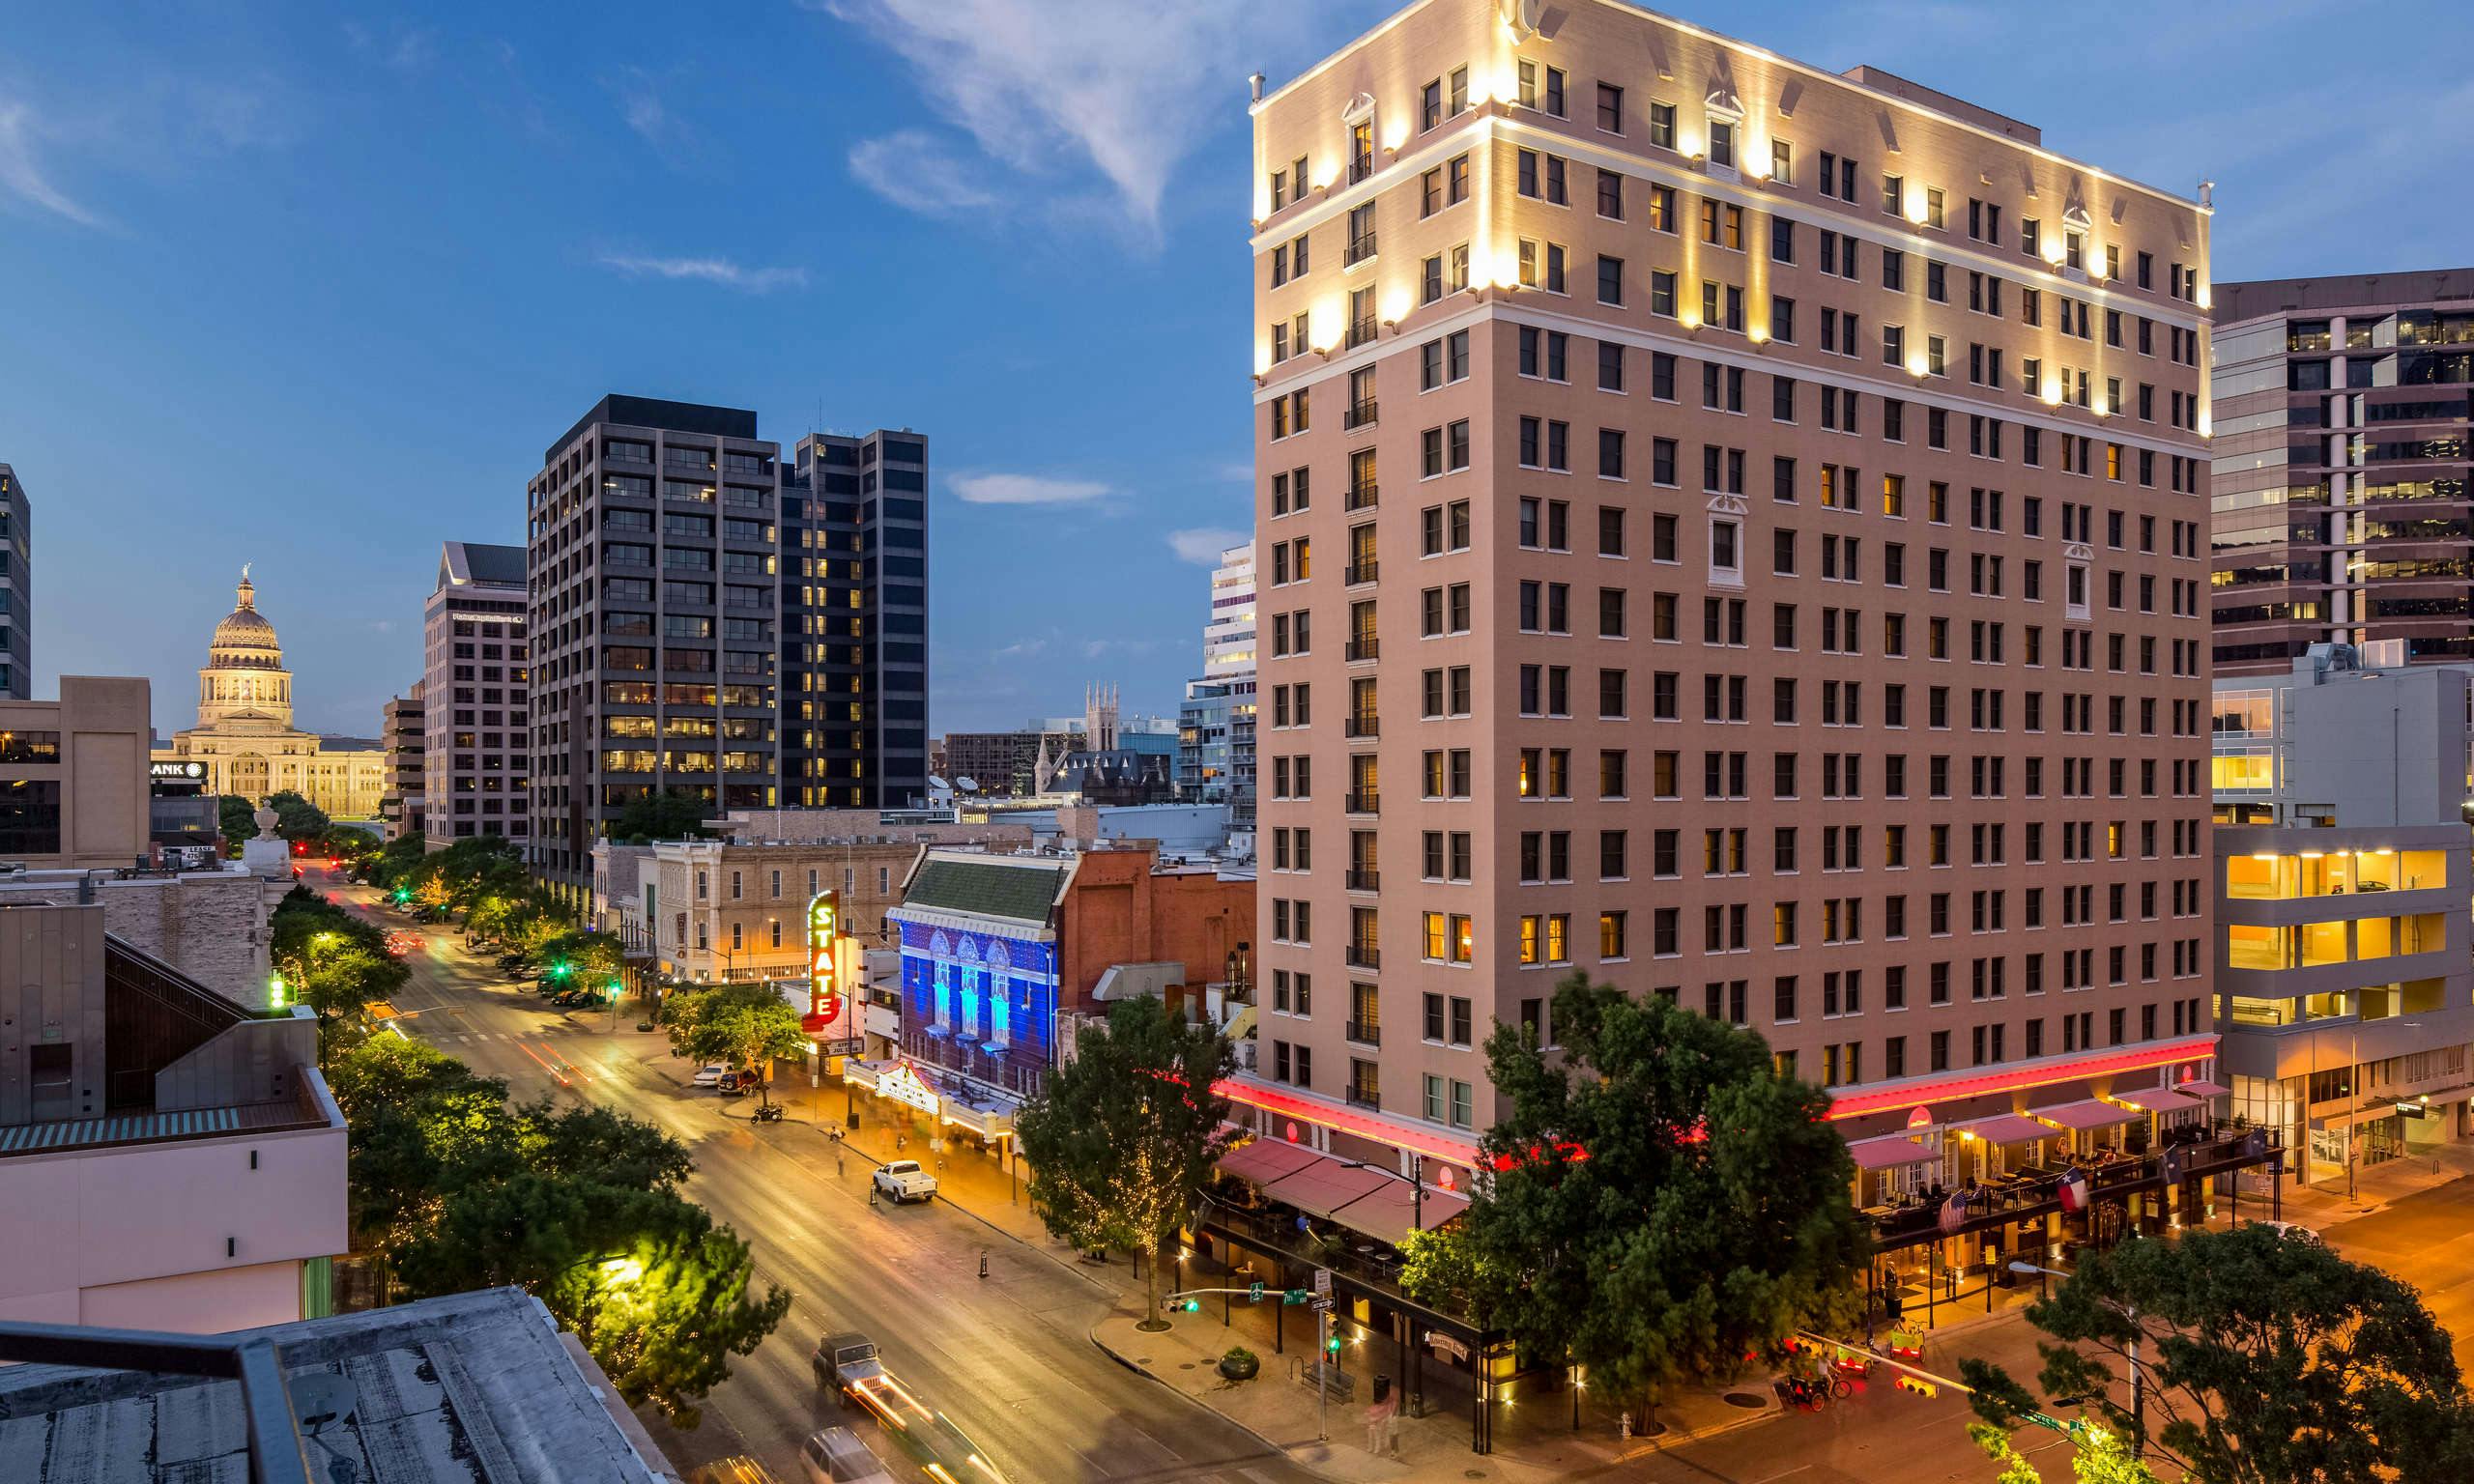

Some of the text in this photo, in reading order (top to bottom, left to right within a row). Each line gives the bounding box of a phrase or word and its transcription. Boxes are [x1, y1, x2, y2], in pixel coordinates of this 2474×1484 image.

[150, 764, 184, 775] ANK
[815, 906, 834, 1015] STATE
[1283, 1293, 1293, 1304] 7th
